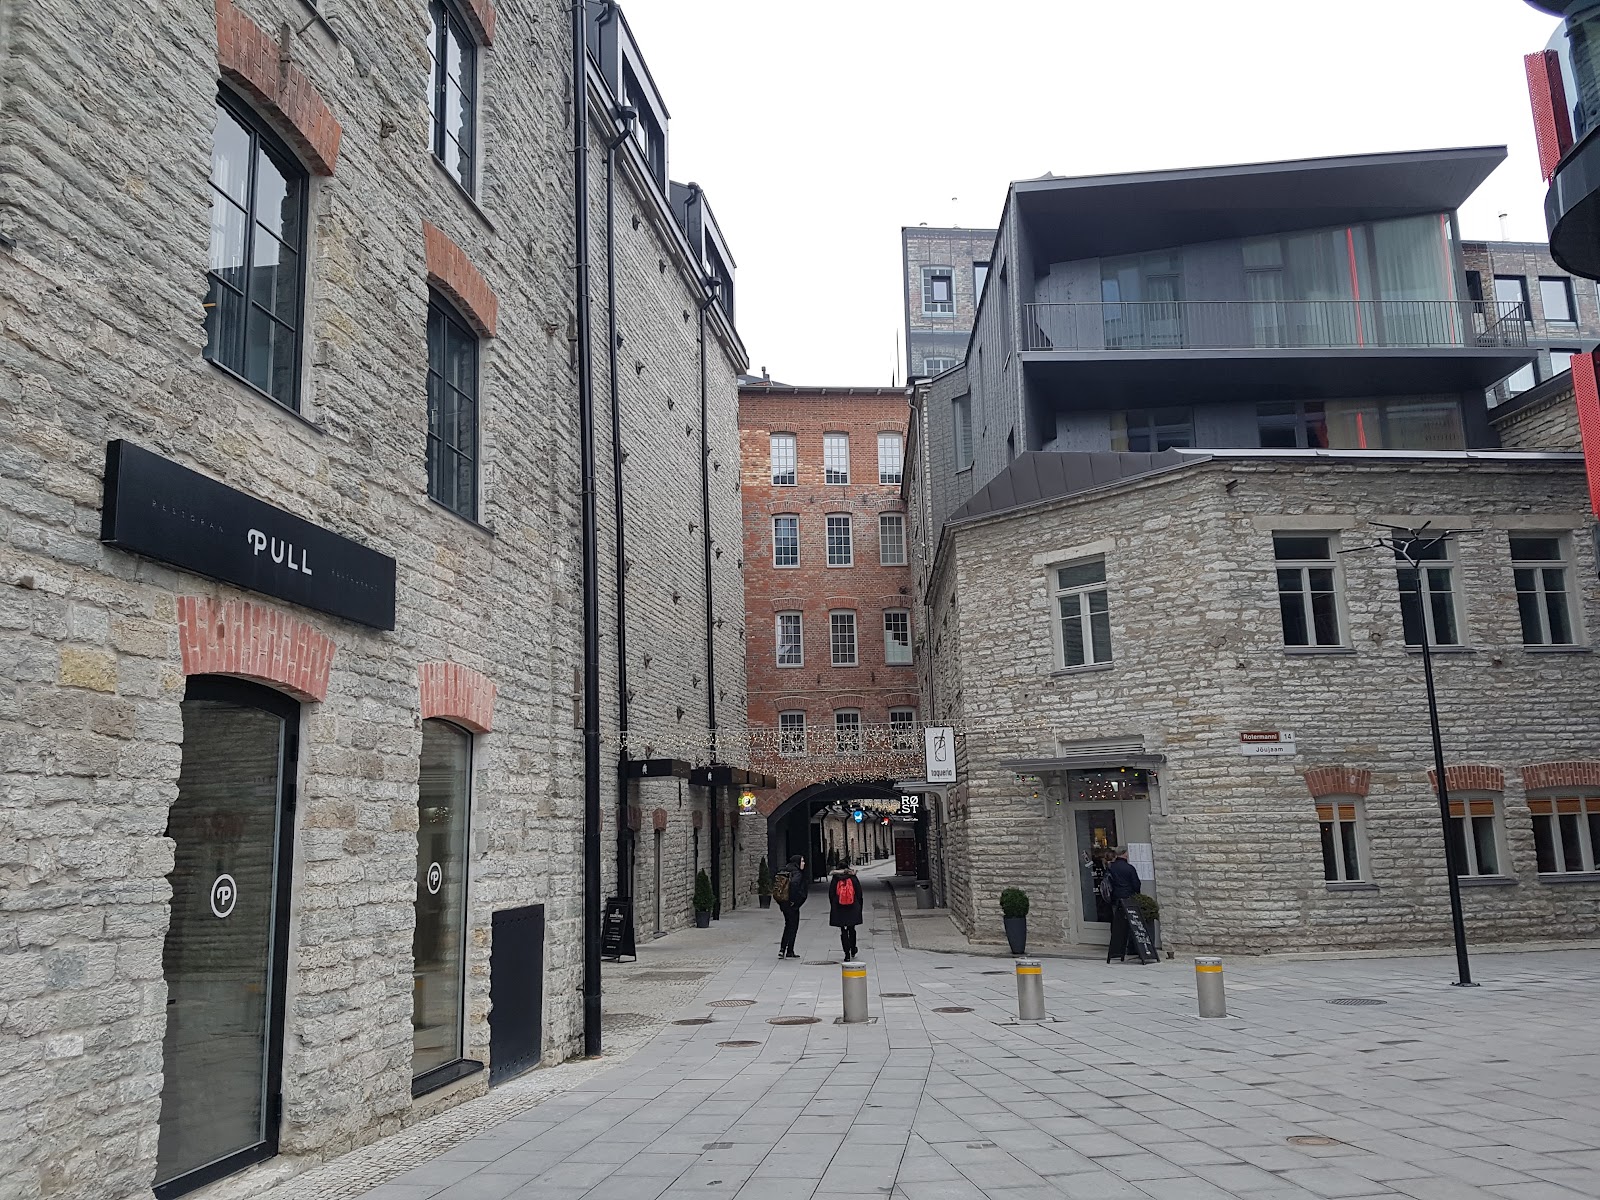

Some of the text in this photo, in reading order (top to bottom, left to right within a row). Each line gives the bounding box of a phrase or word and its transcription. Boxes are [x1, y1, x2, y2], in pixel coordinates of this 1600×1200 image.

[247, 528, 313, 576] PULL
[1255, 746, 1284, 754] Jõujaam
[930, 767, 953, 779] taqueria
